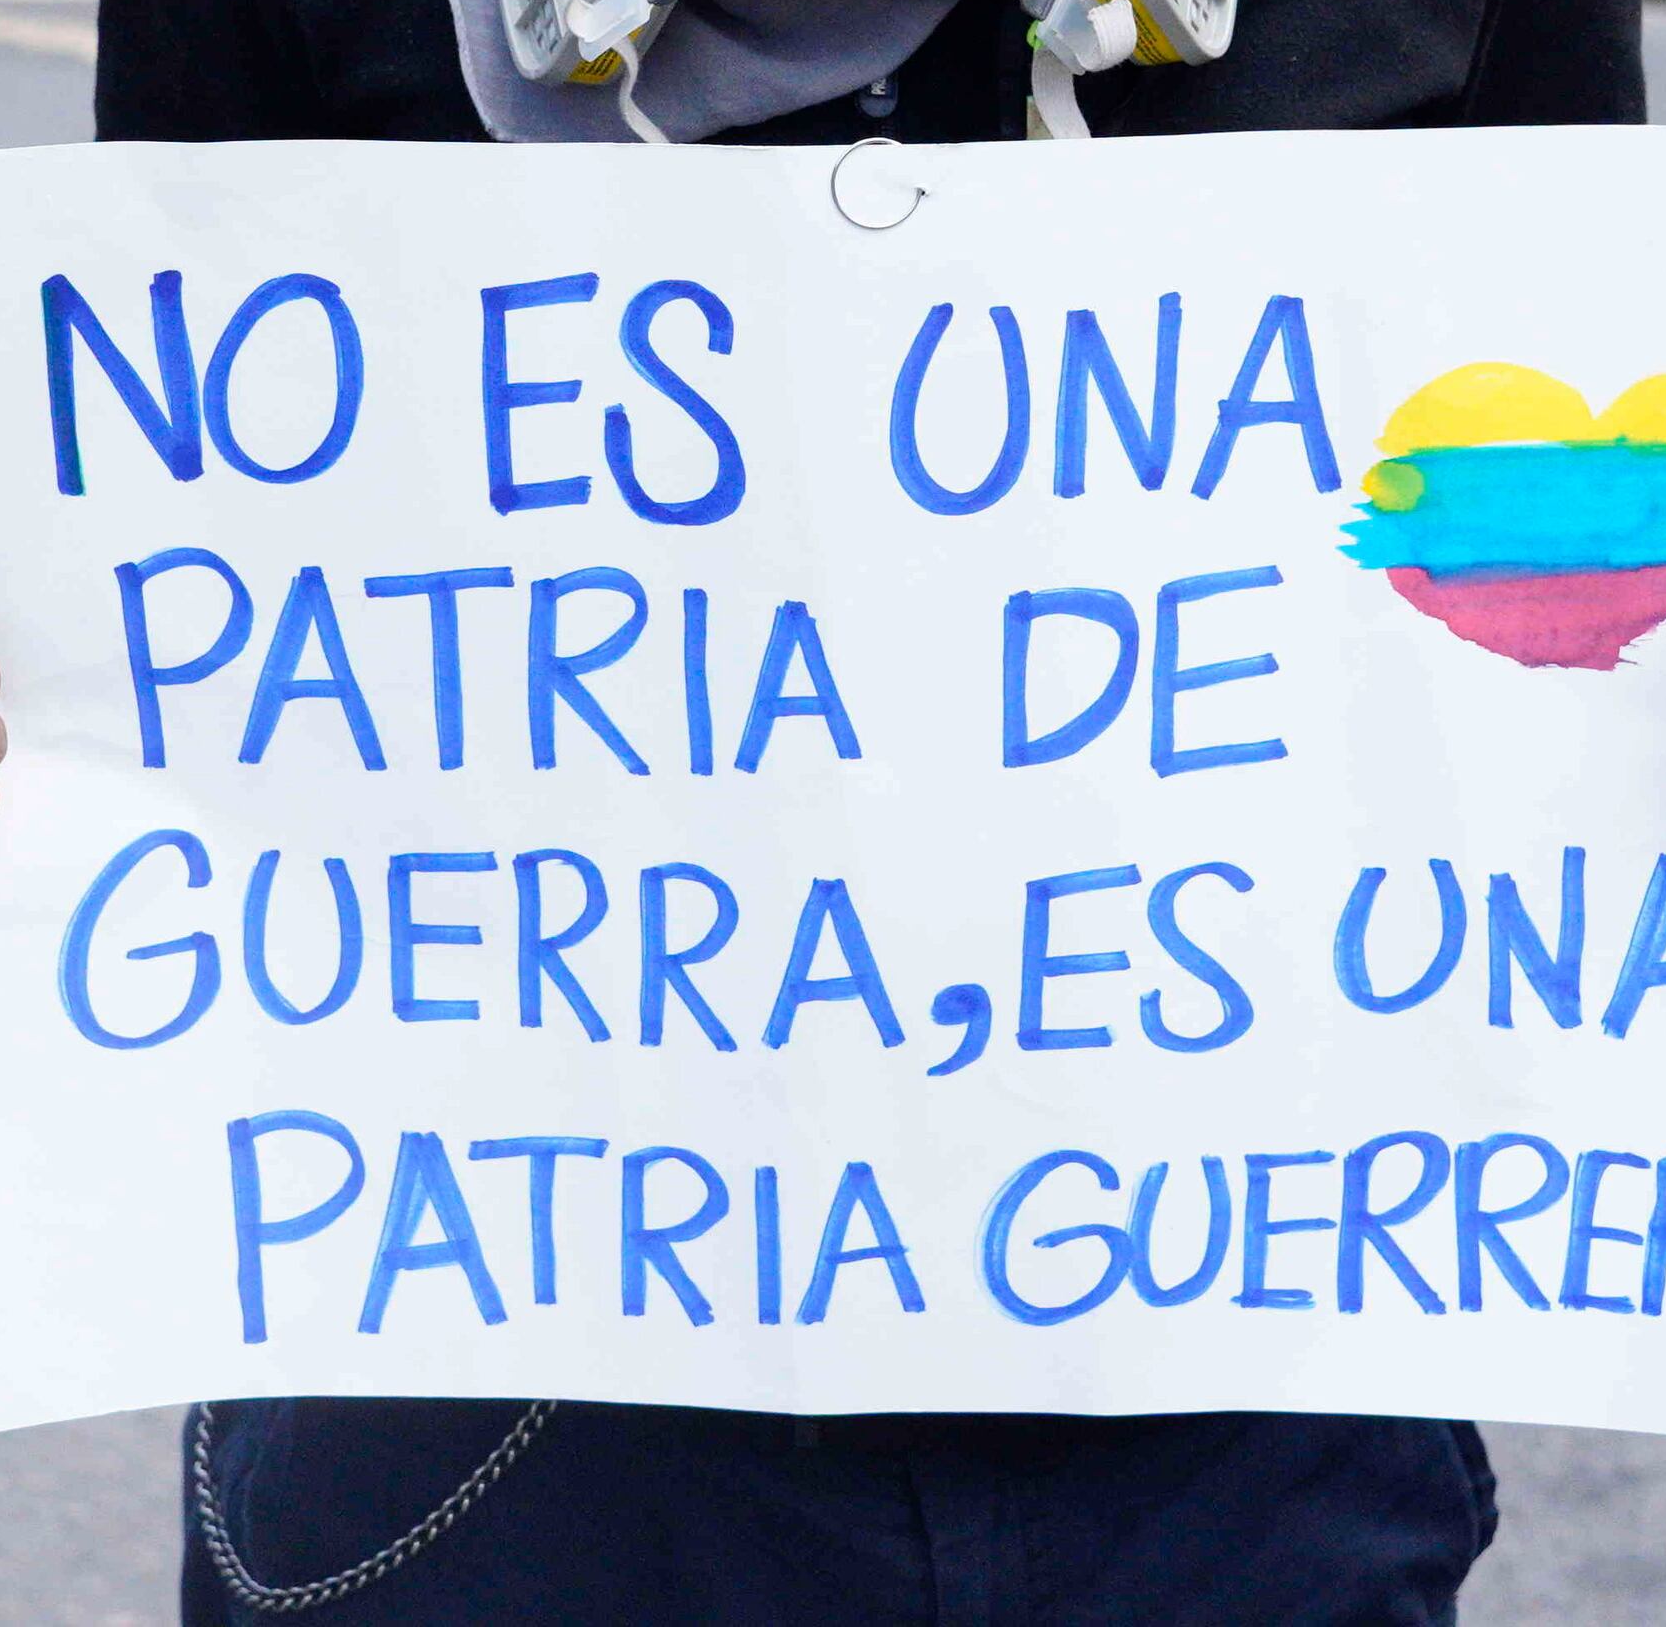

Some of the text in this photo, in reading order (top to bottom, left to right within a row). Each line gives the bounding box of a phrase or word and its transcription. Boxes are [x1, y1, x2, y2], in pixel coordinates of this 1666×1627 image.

[41, 270, 1341, 526] NO ES UNA
[114, 547, 1287, 778] PATRIA DE
[59, 829, 992, 1076] GUERRA,
[1016, 862, 1254, 1053] ES
[227, 1110, 925, 1344] PATRIA
